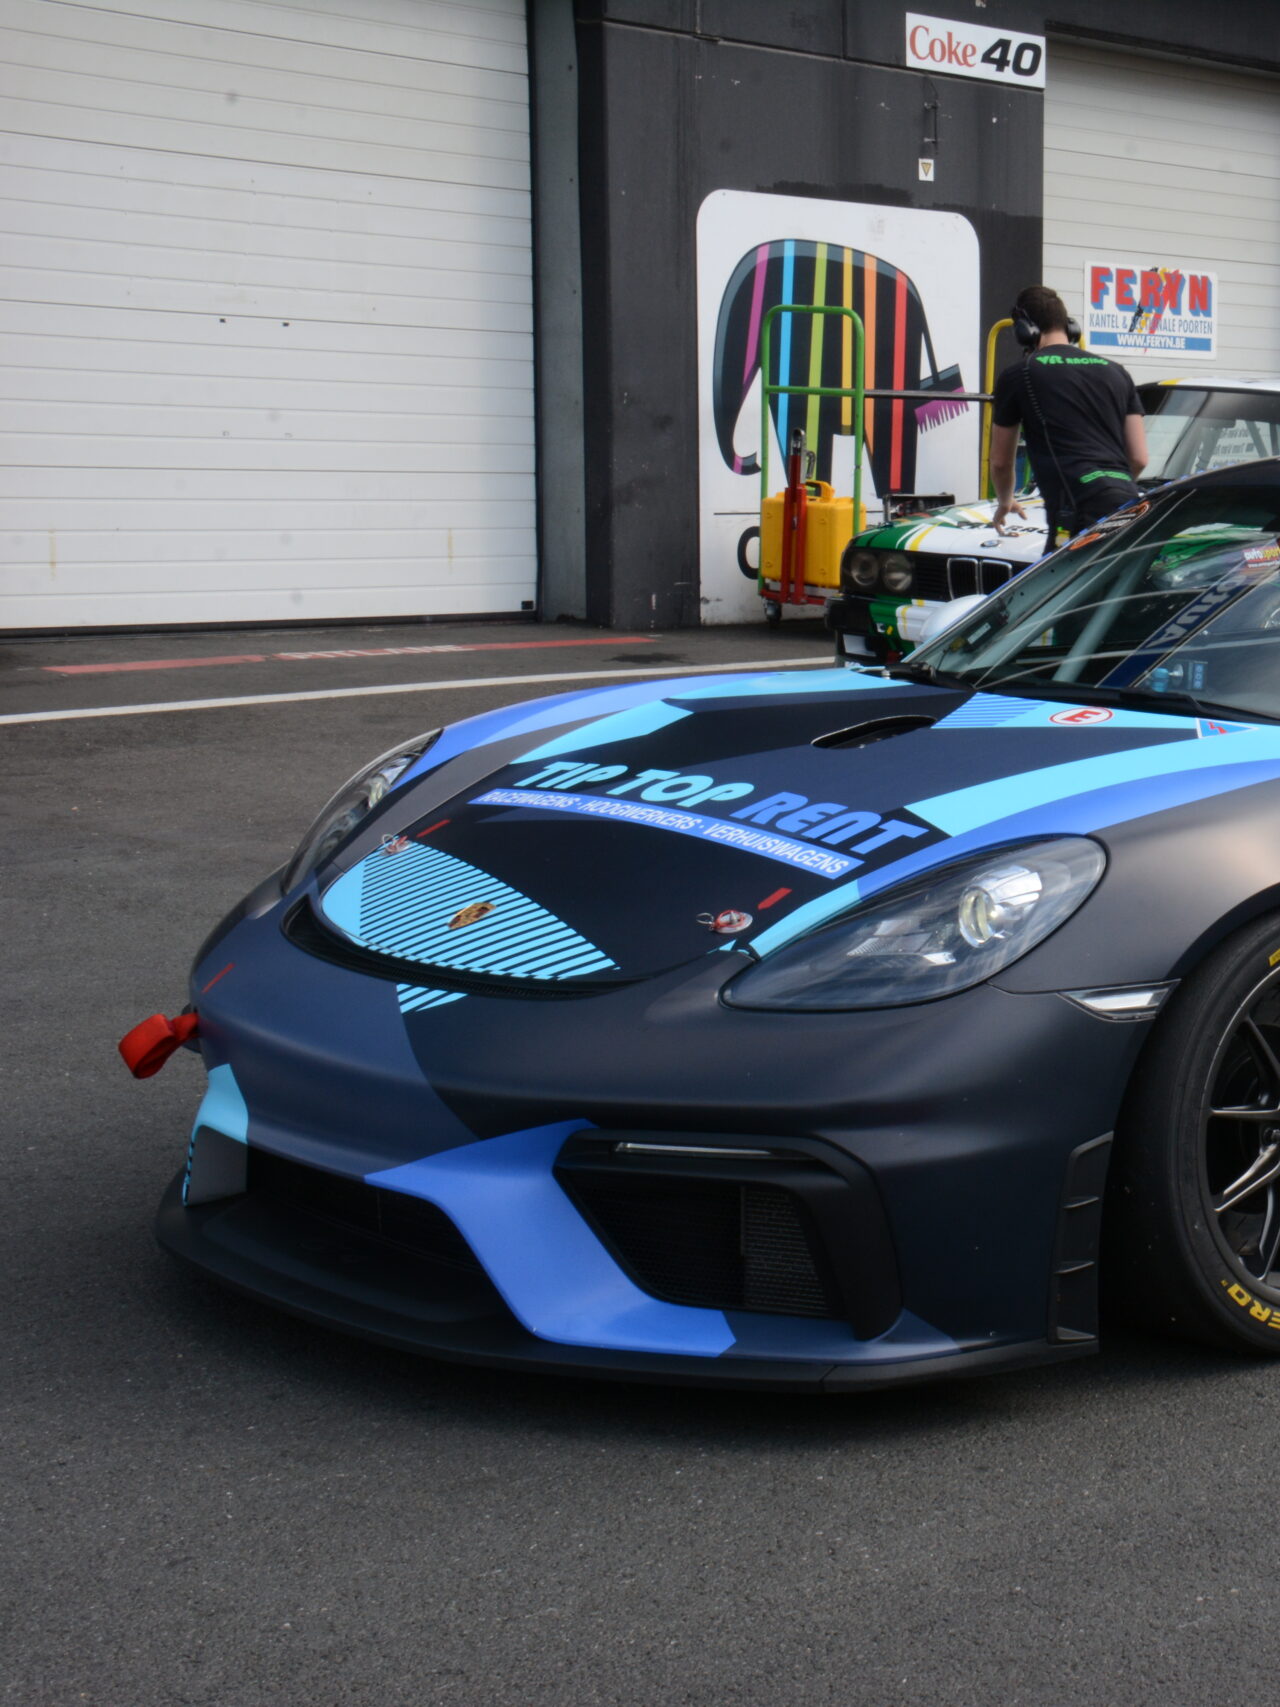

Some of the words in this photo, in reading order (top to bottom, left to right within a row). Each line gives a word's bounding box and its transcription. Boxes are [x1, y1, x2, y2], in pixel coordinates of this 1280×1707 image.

[909, 25, 977, 68] Coke
[980, 38, 1042, 77] 40
[1090, 266, 1213, 318] FERYN
[1089, 313, 1120, 329] KANTEL
[1178, 318, 1213, 334] POORTEN
[1062, 710, 1101, 723] E
[481, 789, 579, 808] RACEWAGENS
[582, 799, 701, 830] HOOGWERKERS
[703, 822, 850, 874] VERHUISWAGENS
[513, 760, 629, 790] TIP
[606, 768, 755, 808] TOP
[729, 791, 930, 855] RENT
